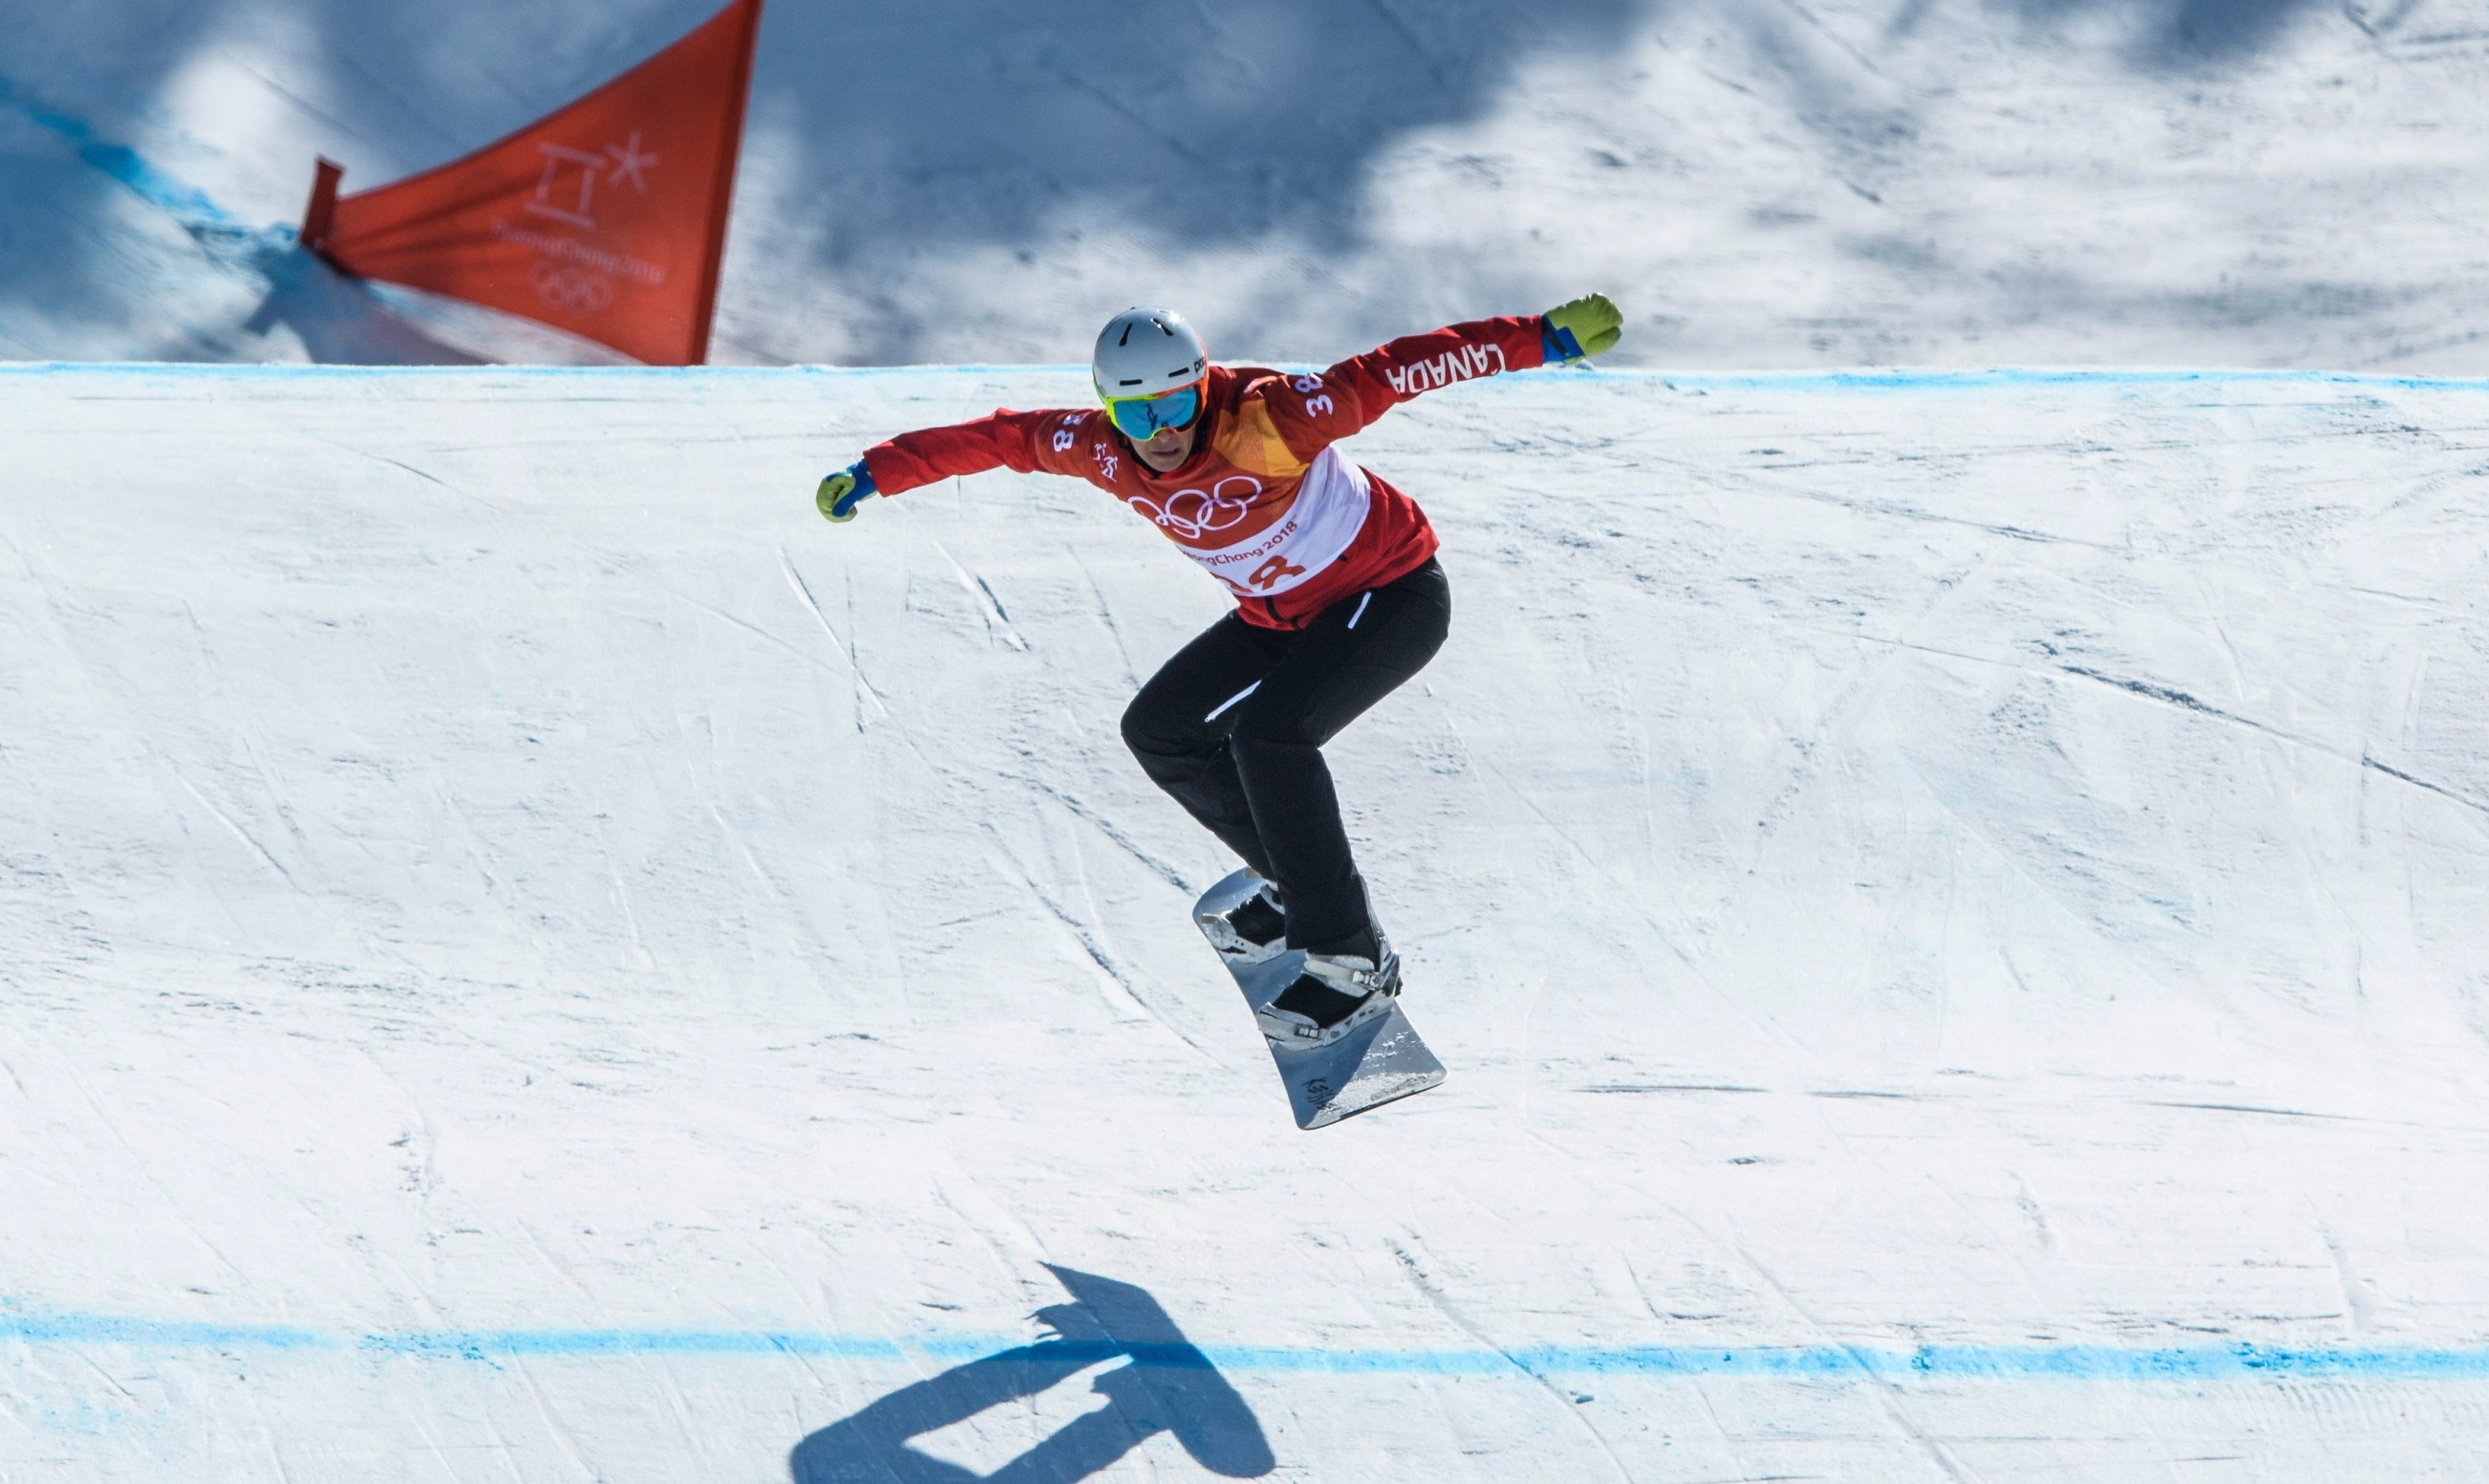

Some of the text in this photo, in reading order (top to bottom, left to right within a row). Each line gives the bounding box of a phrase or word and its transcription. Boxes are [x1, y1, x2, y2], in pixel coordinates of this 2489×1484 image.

[1385, 344, 1506, 394] CANADA
[1295, 371, 1334, 418] 38
[1262, 520, 1298, 551] 2018
